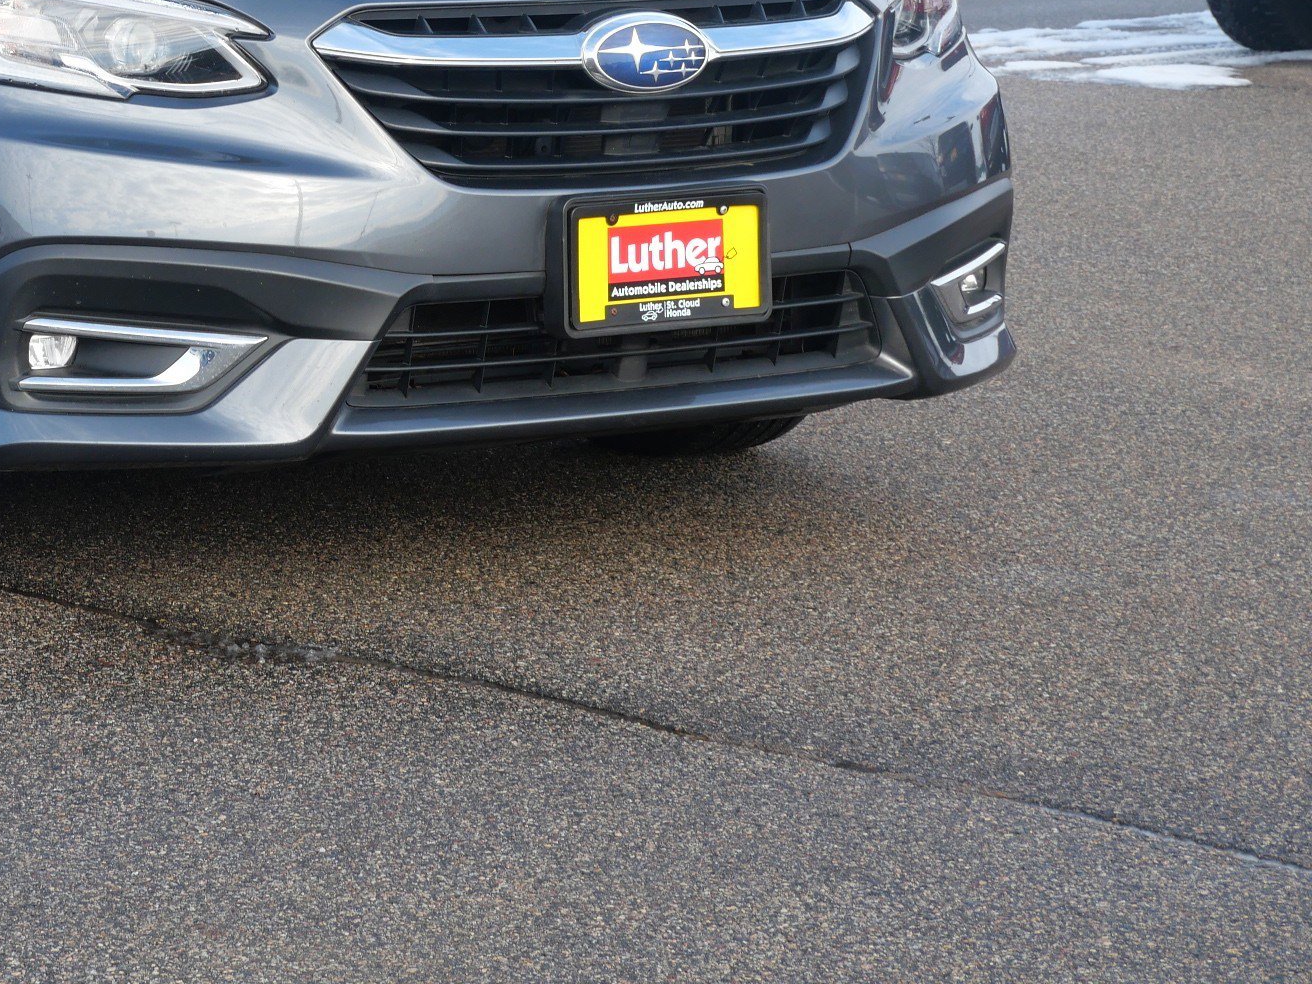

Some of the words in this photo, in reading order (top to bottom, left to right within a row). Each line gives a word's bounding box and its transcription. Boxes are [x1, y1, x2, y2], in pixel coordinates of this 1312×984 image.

[634, 200, 704, 213] LutherAuto.com
[611, 231, 721, 274] Luther
[611, 283, 667, 297] Automobile
[668, 278, 722, 292] Dealerships
[639, 302, 662, 311] Luther
[666, 301, 677, 309] St.
[678, 298, 700, 308] Cloud
[666, 308, 691, 317] Honda
